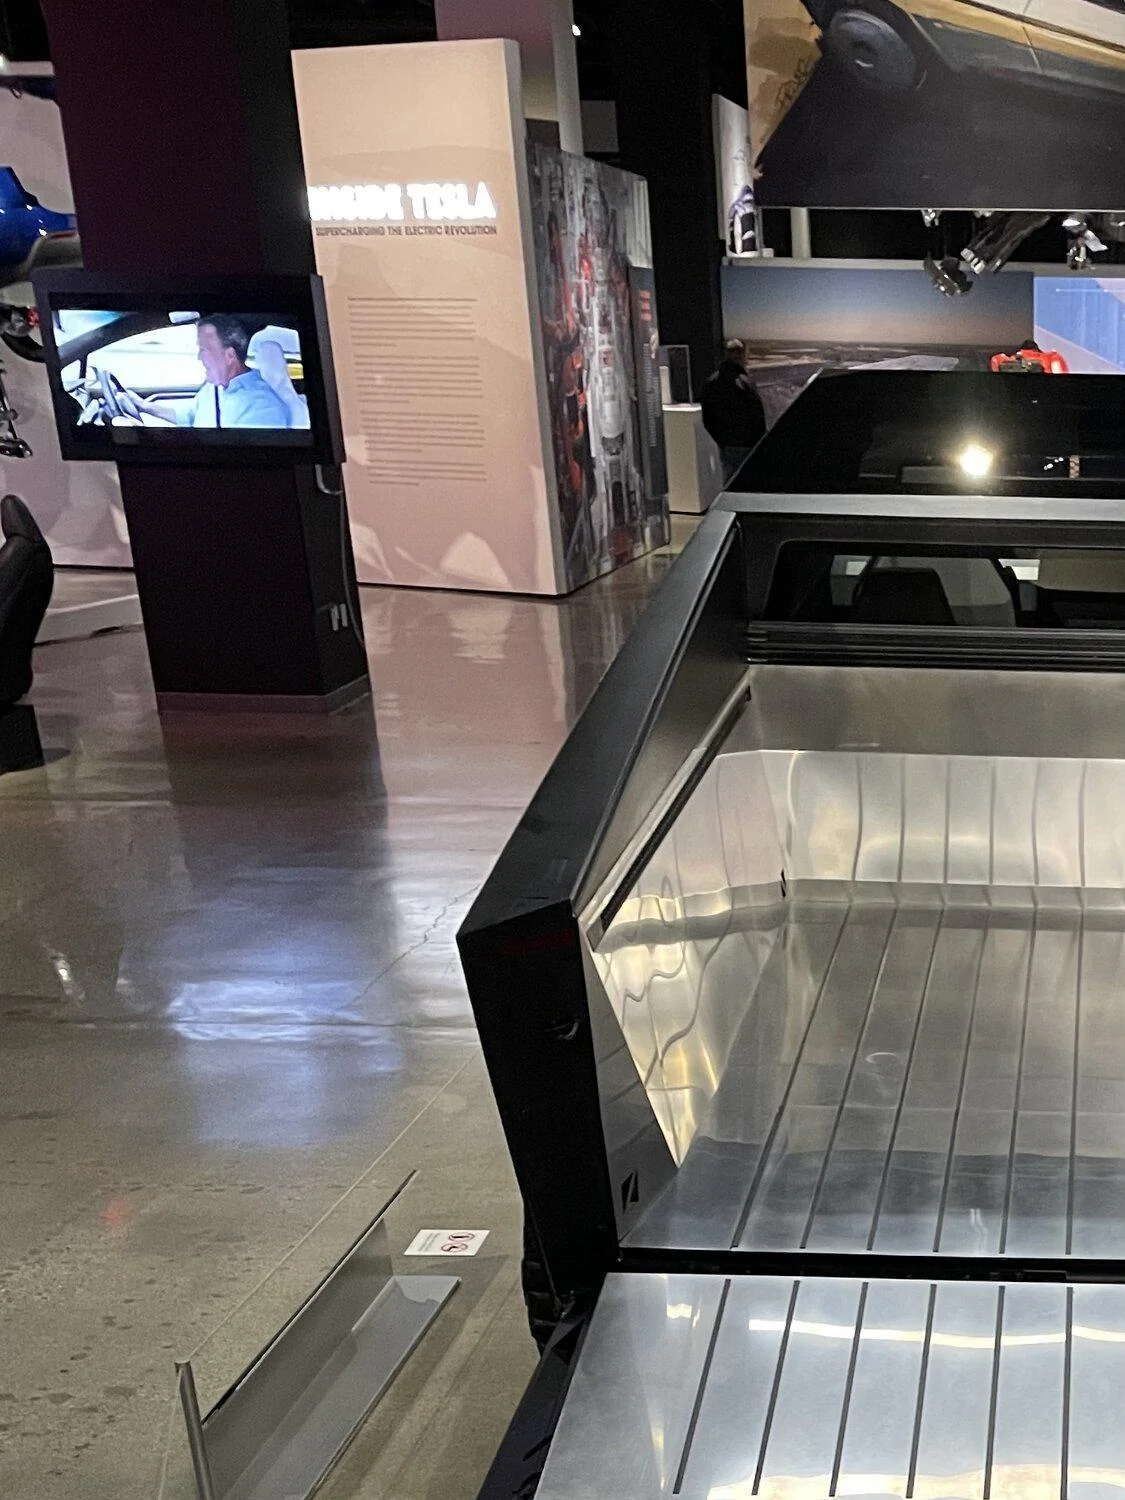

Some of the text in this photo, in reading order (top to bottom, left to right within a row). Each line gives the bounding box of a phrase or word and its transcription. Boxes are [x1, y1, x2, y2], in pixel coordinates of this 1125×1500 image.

[406, 181, 497, 220] TESLA
[315, 225, 498, 237] SUPERCHARGING THE ELECTRIC REVOLUTION
